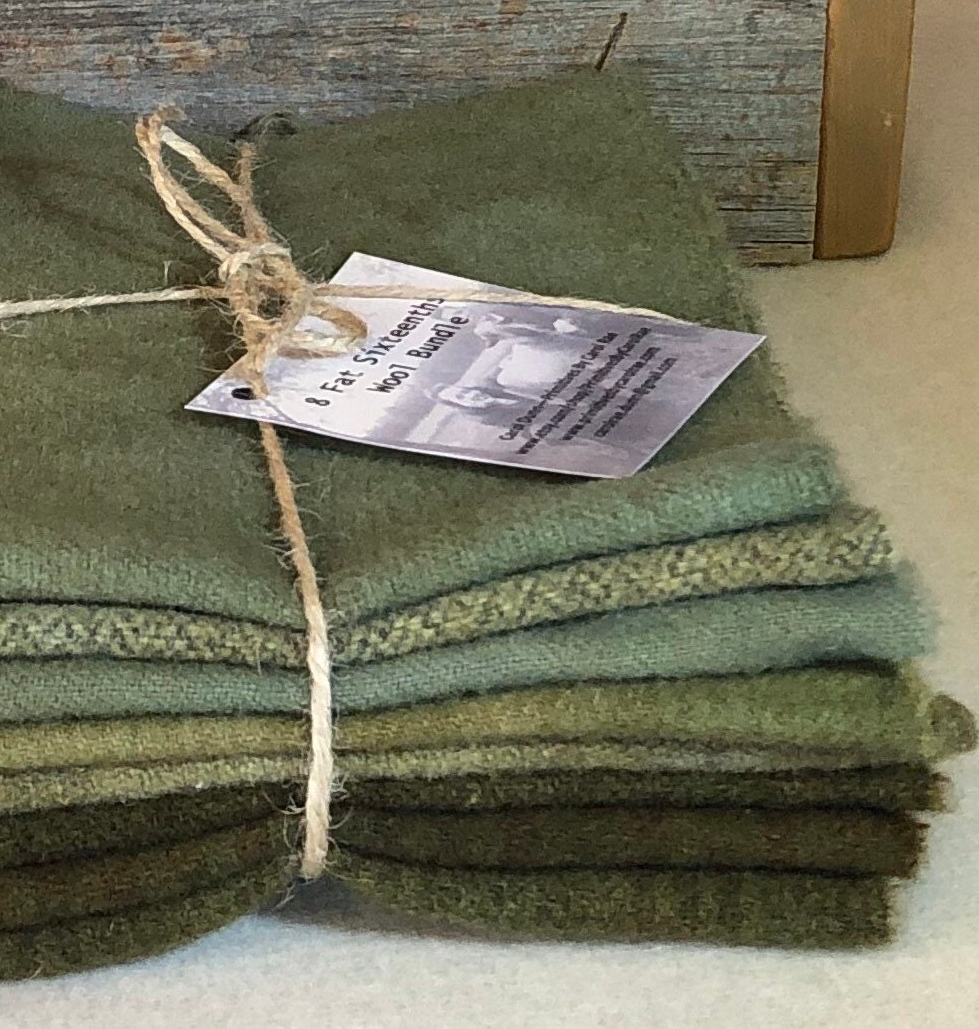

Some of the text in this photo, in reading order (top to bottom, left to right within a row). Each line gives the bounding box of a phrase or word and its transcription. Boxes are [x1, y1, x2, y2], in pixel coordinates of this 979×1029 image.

[305, 297, 445, 407] 8 Fat Sixteenths
[366, 316, 469, 393] Wool Bundle
[581, 343, 605, 360] Carol
